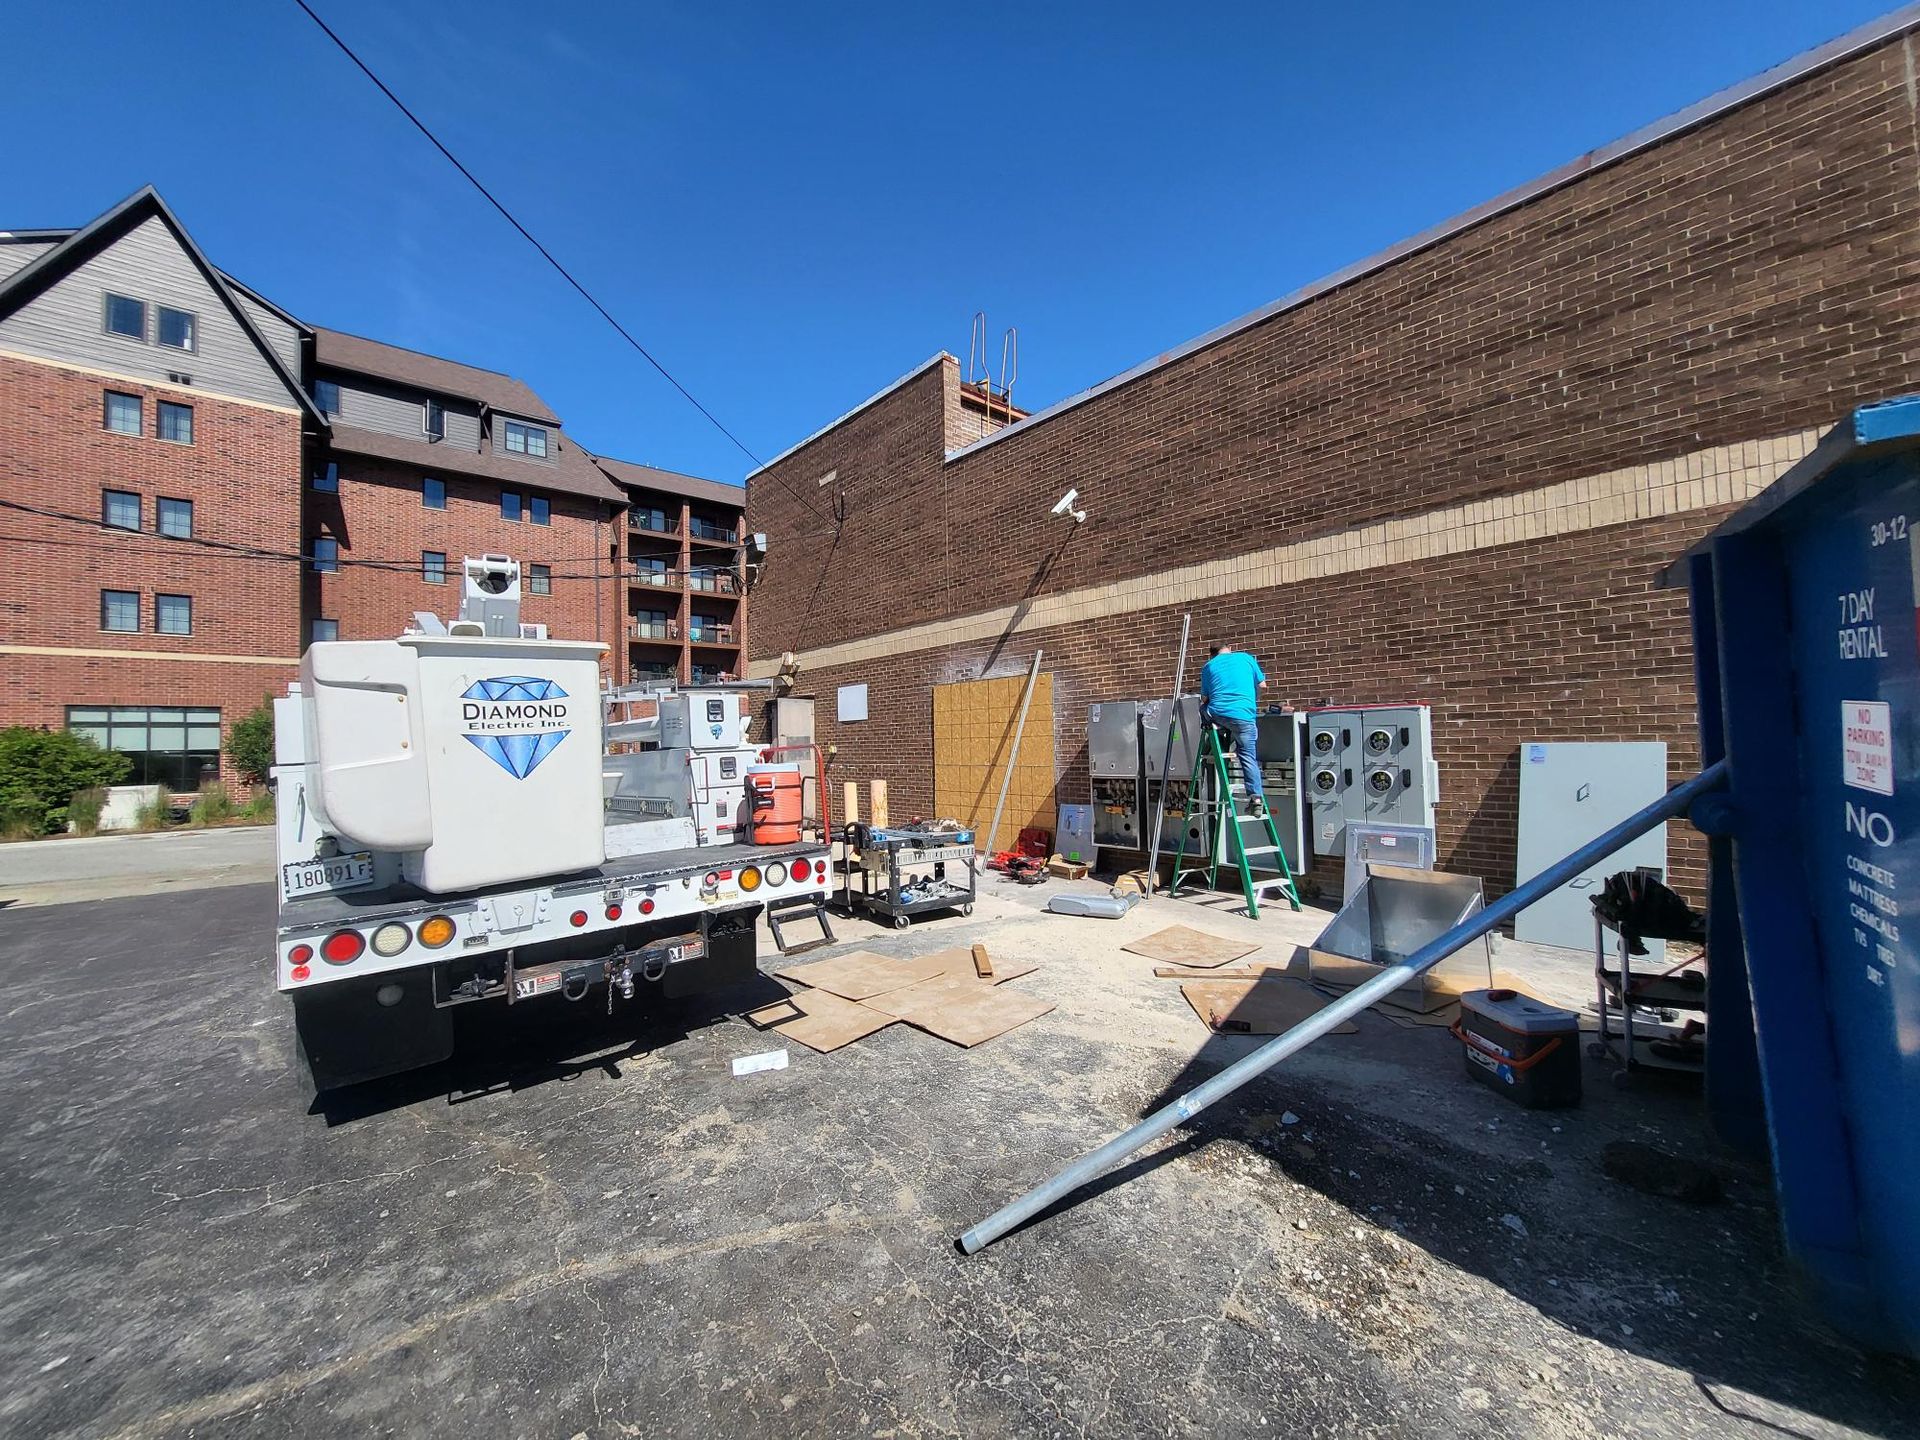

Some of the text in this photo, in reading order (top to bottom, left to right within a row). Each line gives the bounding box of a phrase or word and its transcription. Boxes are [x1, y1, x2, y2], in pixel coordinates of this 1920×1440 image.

[1871, 515, 1907, 547] 30-12
[1838, 587, 1875, 625] 7 DAY
[1838, 625, 1888, 660] RENTAL
[462, 703, 567, 721] DIAMOND
[468, 720, 571, 731] Electric Inc.
[1858, 708, 1872, 725] NO
[1847, 728, 1885, 748] PARKING
[1846, 749, 1888, 769] TOW AWAY
[1856, 766, 1877, 784] ZONE
[1845, 801, 1894, 848] NO
[295, 863, 367, 890] 180891 F
[1846, 854, 1896, 890] CONCRETE
[1848, 877, 1898, 917] MATTRESS
[1850, 902, 1899, 942] CHEMICALS
